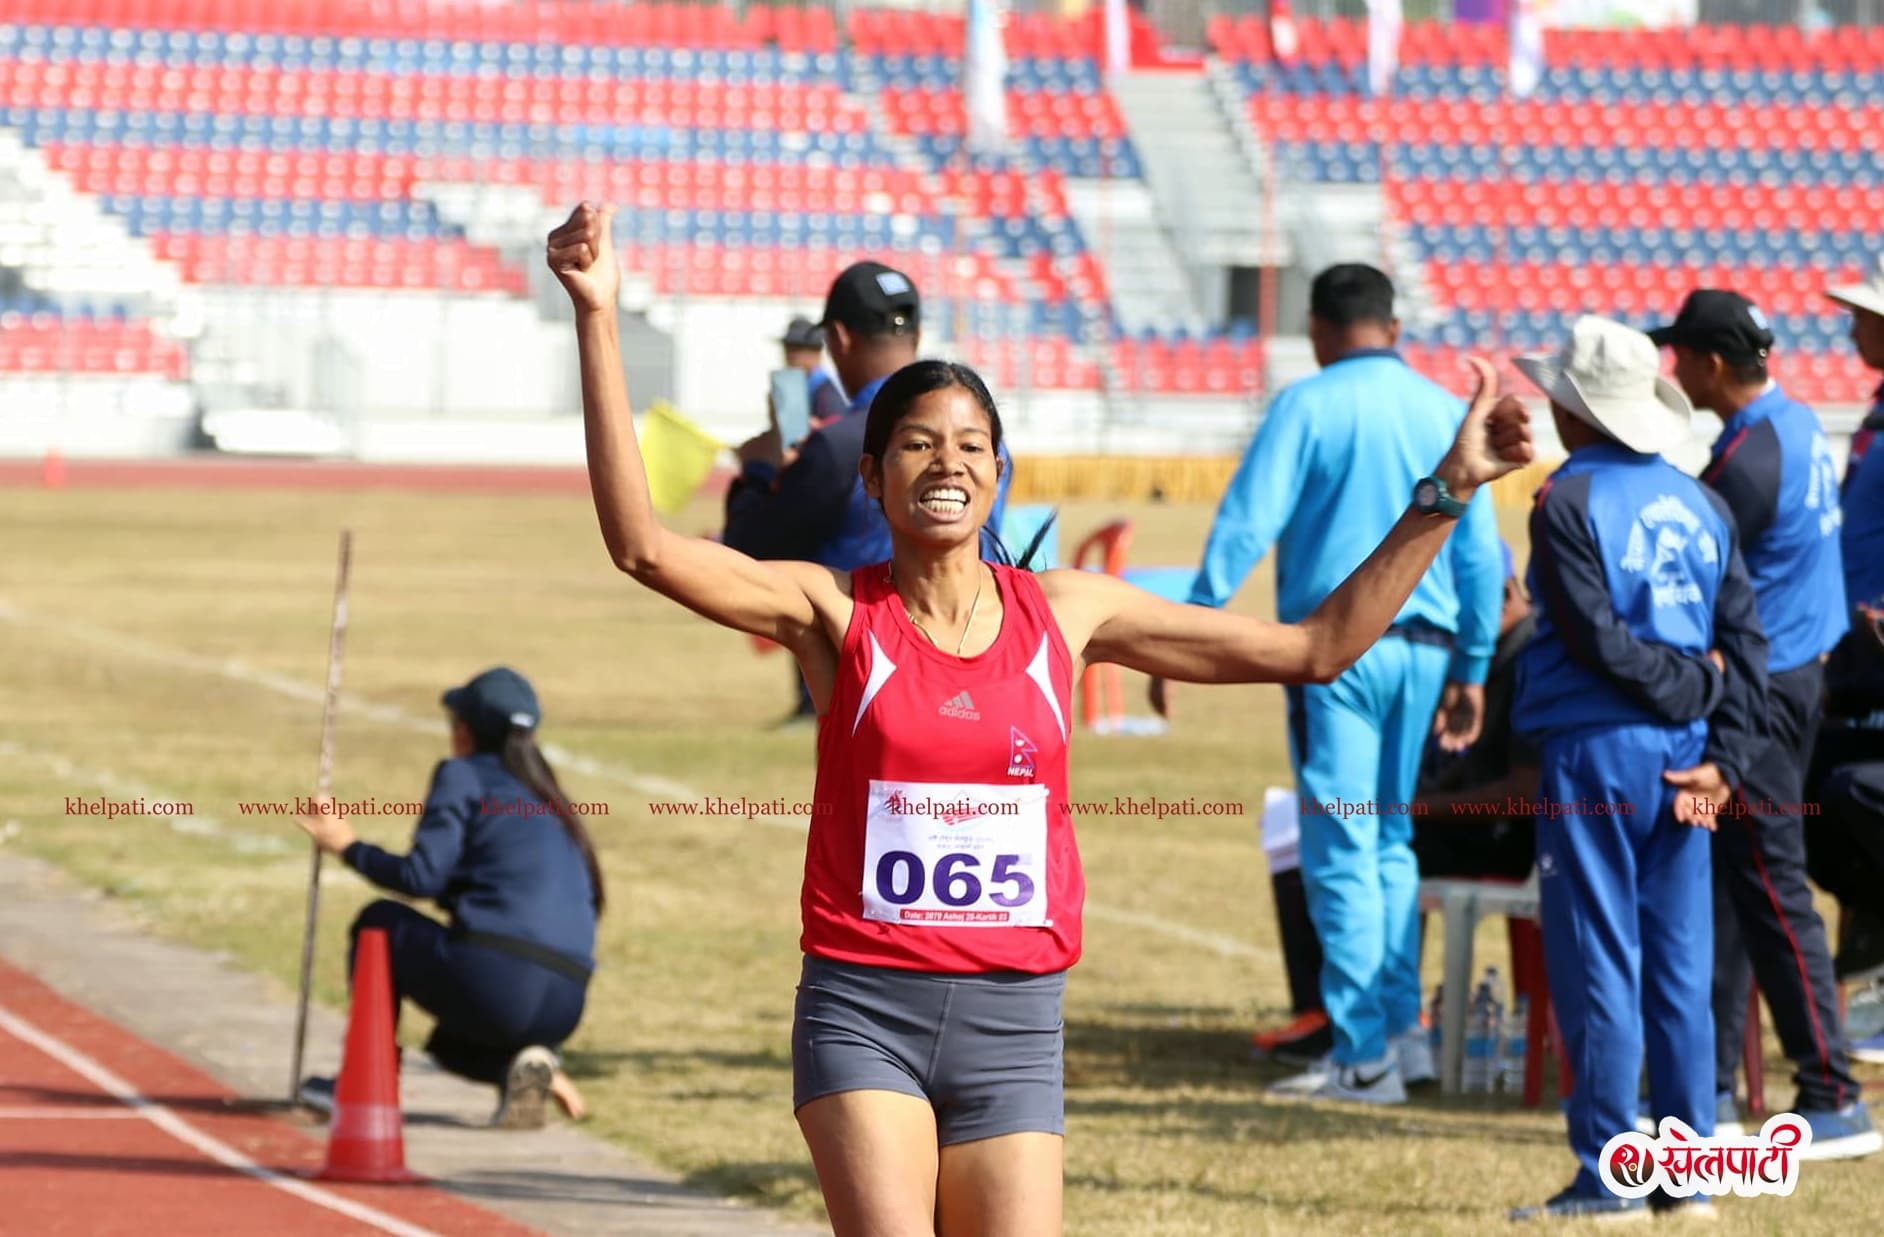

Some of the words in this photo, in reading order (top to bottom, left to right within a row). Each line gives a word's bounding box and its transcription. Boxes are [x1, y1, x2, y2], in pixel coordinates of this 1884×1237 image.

[938, 706, 981, 721] adidas
[1007, 767, 1034, 777] NEPAL
[875, 851, 1035, 907] 065
